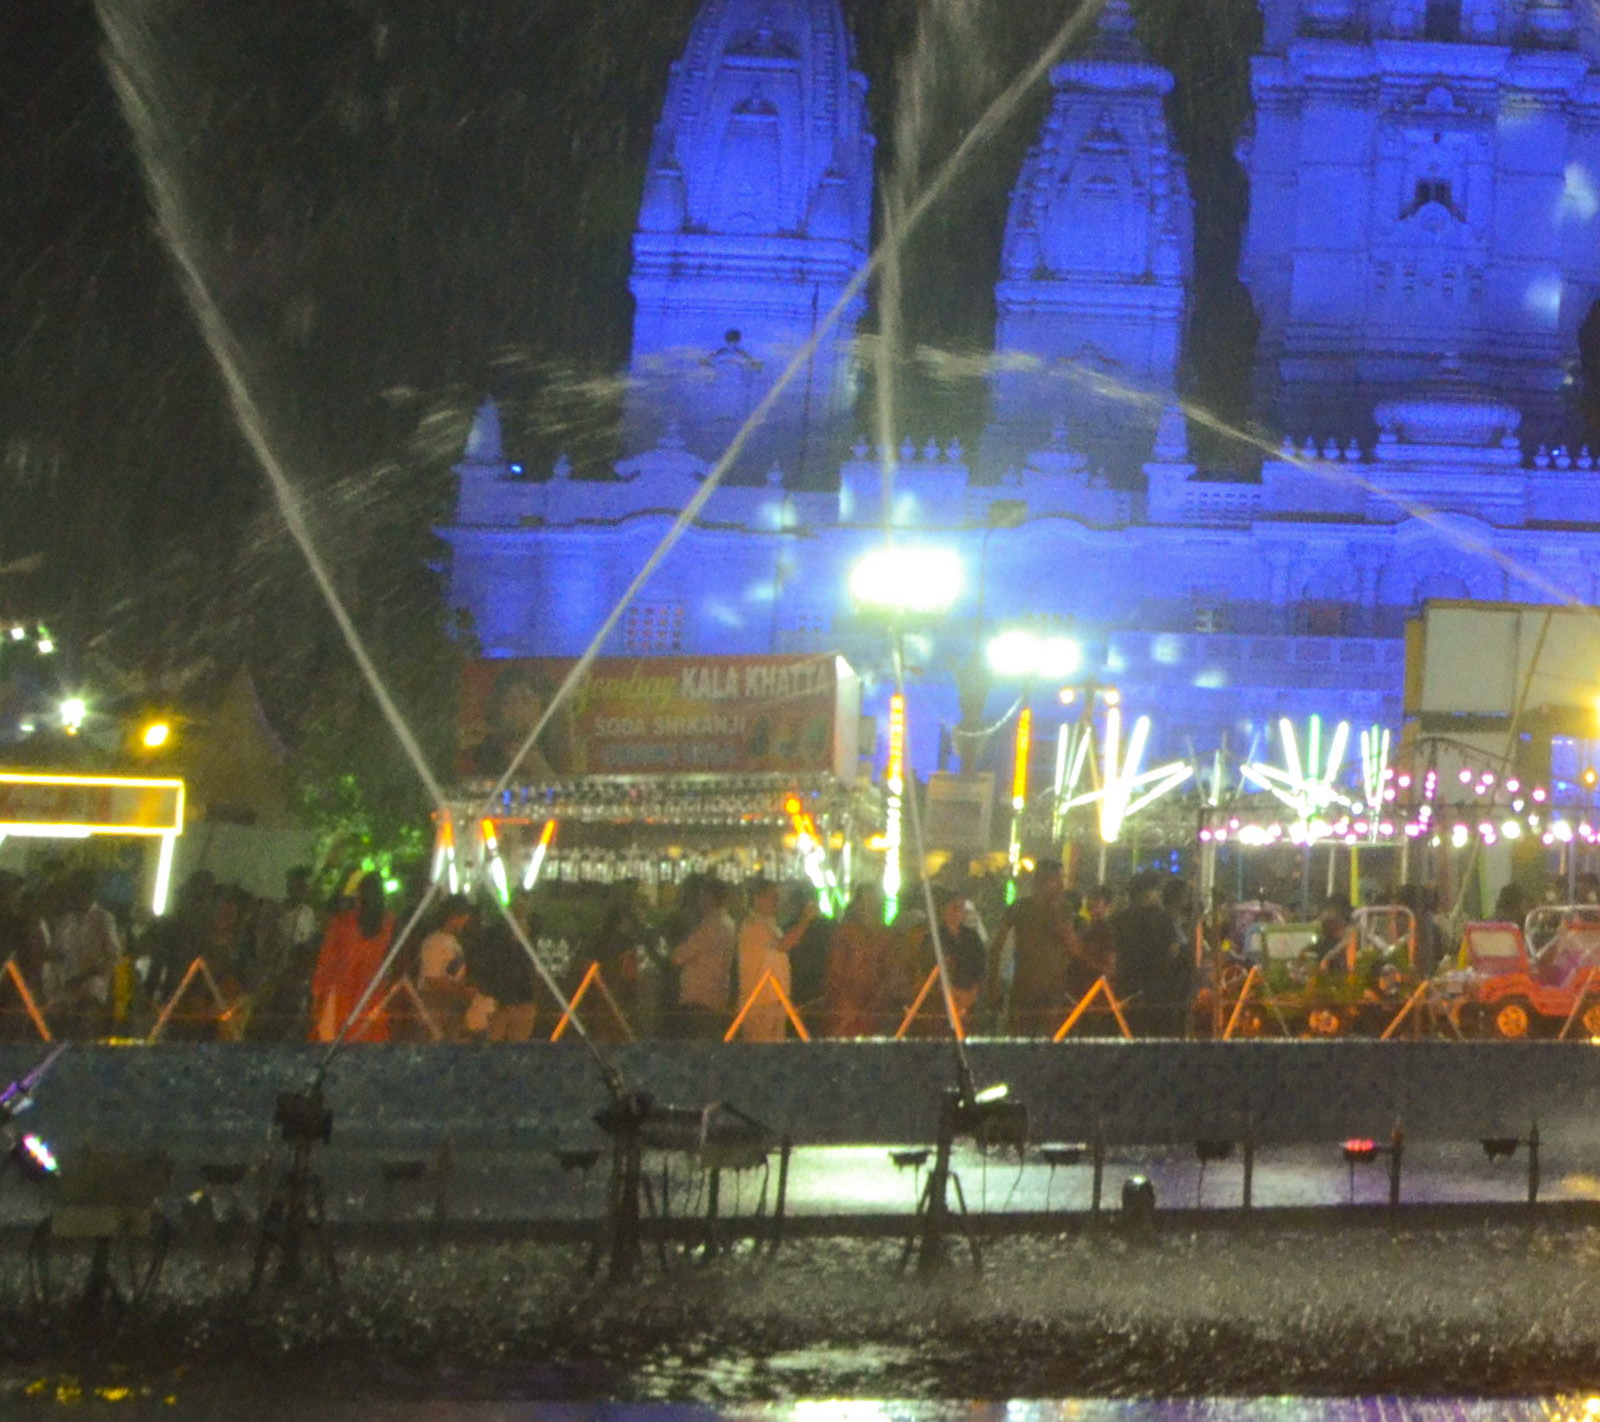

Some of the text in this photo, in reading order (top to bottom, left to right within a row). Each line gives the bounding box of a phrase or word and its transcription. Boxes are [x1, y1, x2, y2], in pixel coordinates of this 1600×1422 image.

[682, 666, 739, 698] KALA
[745, 664, 829, 697] KHATTA
[594, 716, 647, 736] SODA
